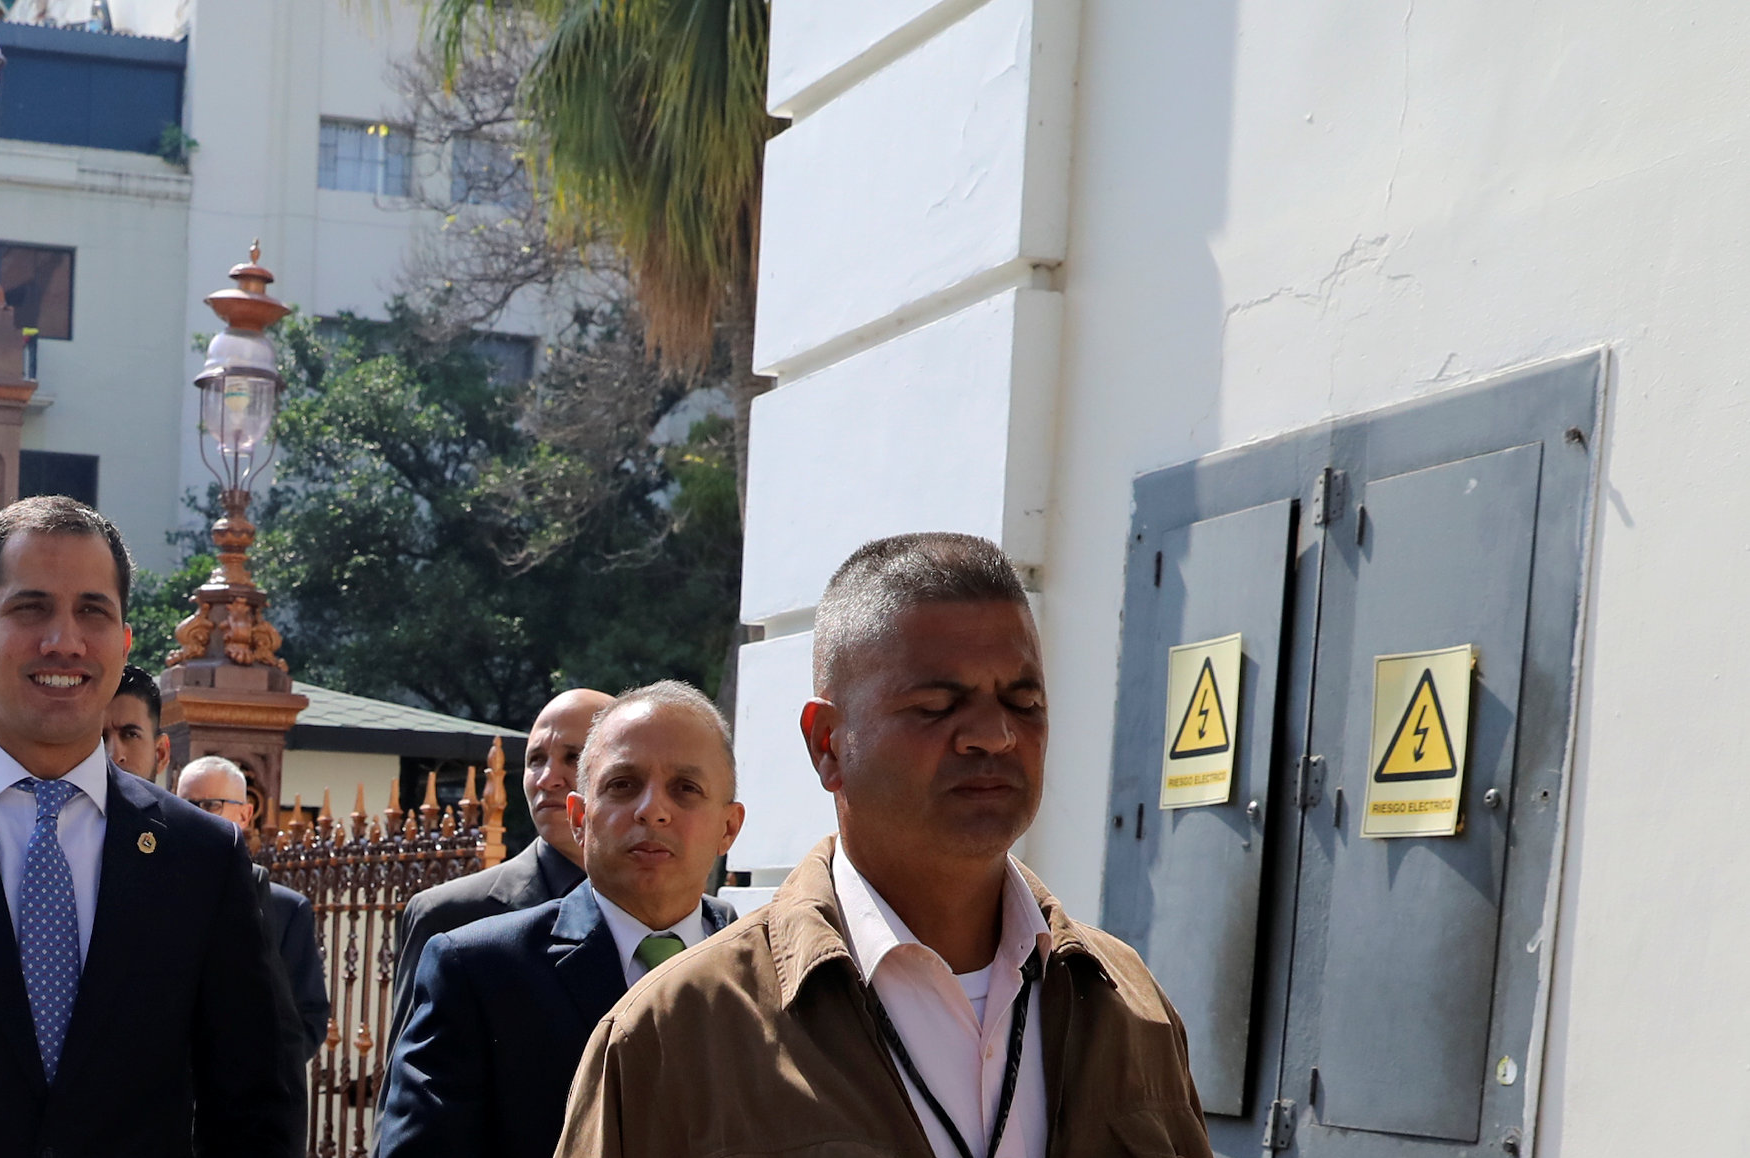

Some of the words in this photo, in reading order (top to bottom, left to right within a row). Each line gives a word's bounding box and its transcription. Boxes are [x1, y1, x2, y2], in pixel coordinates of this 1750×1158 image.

[1168, 776, 1193, 788] RIESGO
[1372, 802, 1406, 814] RIESGO
[1408, 799, 1453, 813] ELECTRICO
